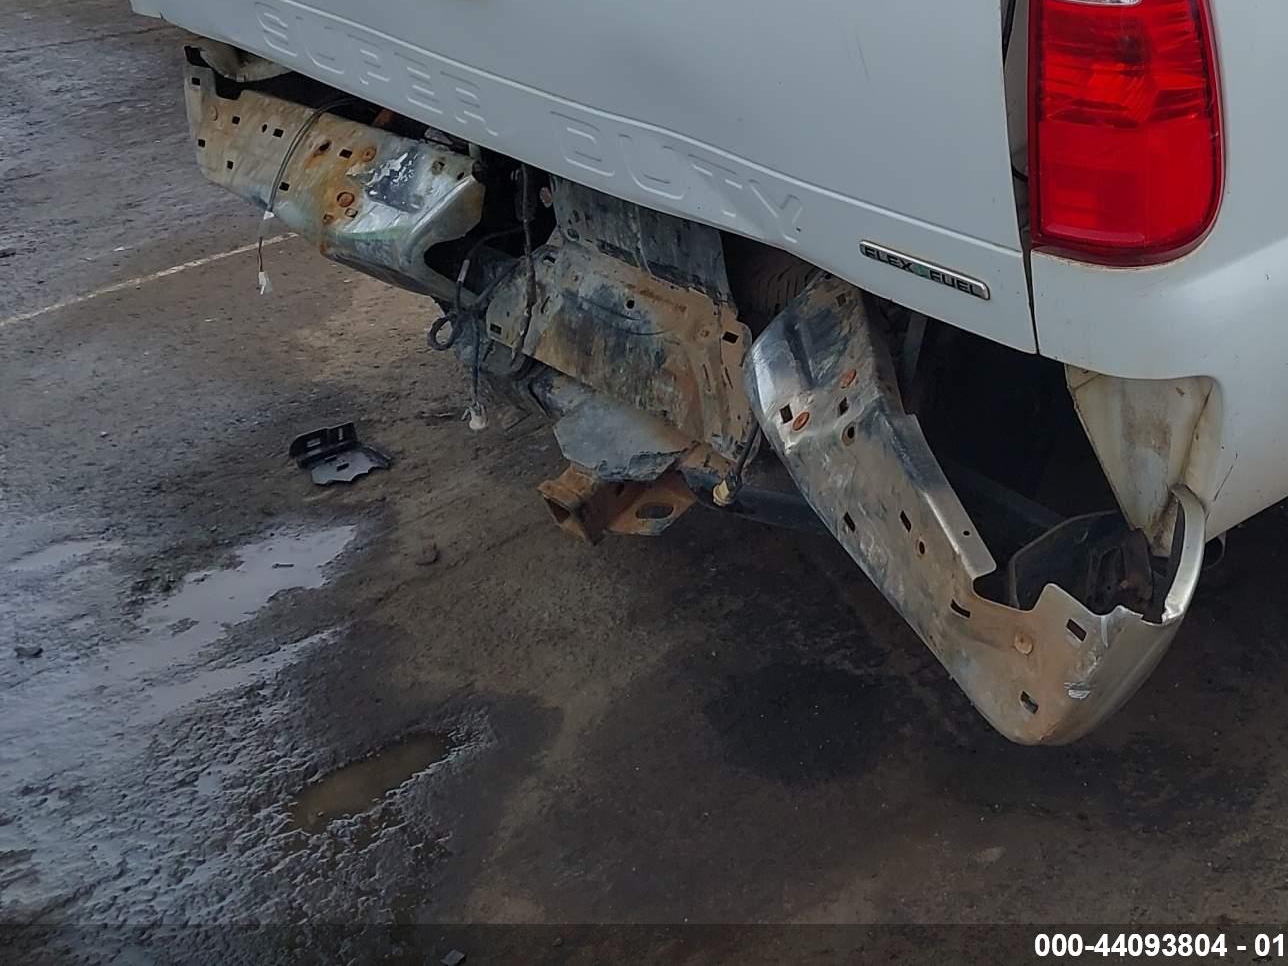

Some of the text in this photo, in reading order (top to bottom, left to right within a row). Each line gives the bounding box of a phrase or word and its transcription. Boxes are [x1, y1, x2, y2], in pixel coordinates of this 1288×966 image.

[254, 1, 803, 244] SUPER DUTY
[864, 245, 983, 298] FLEX FUEL
